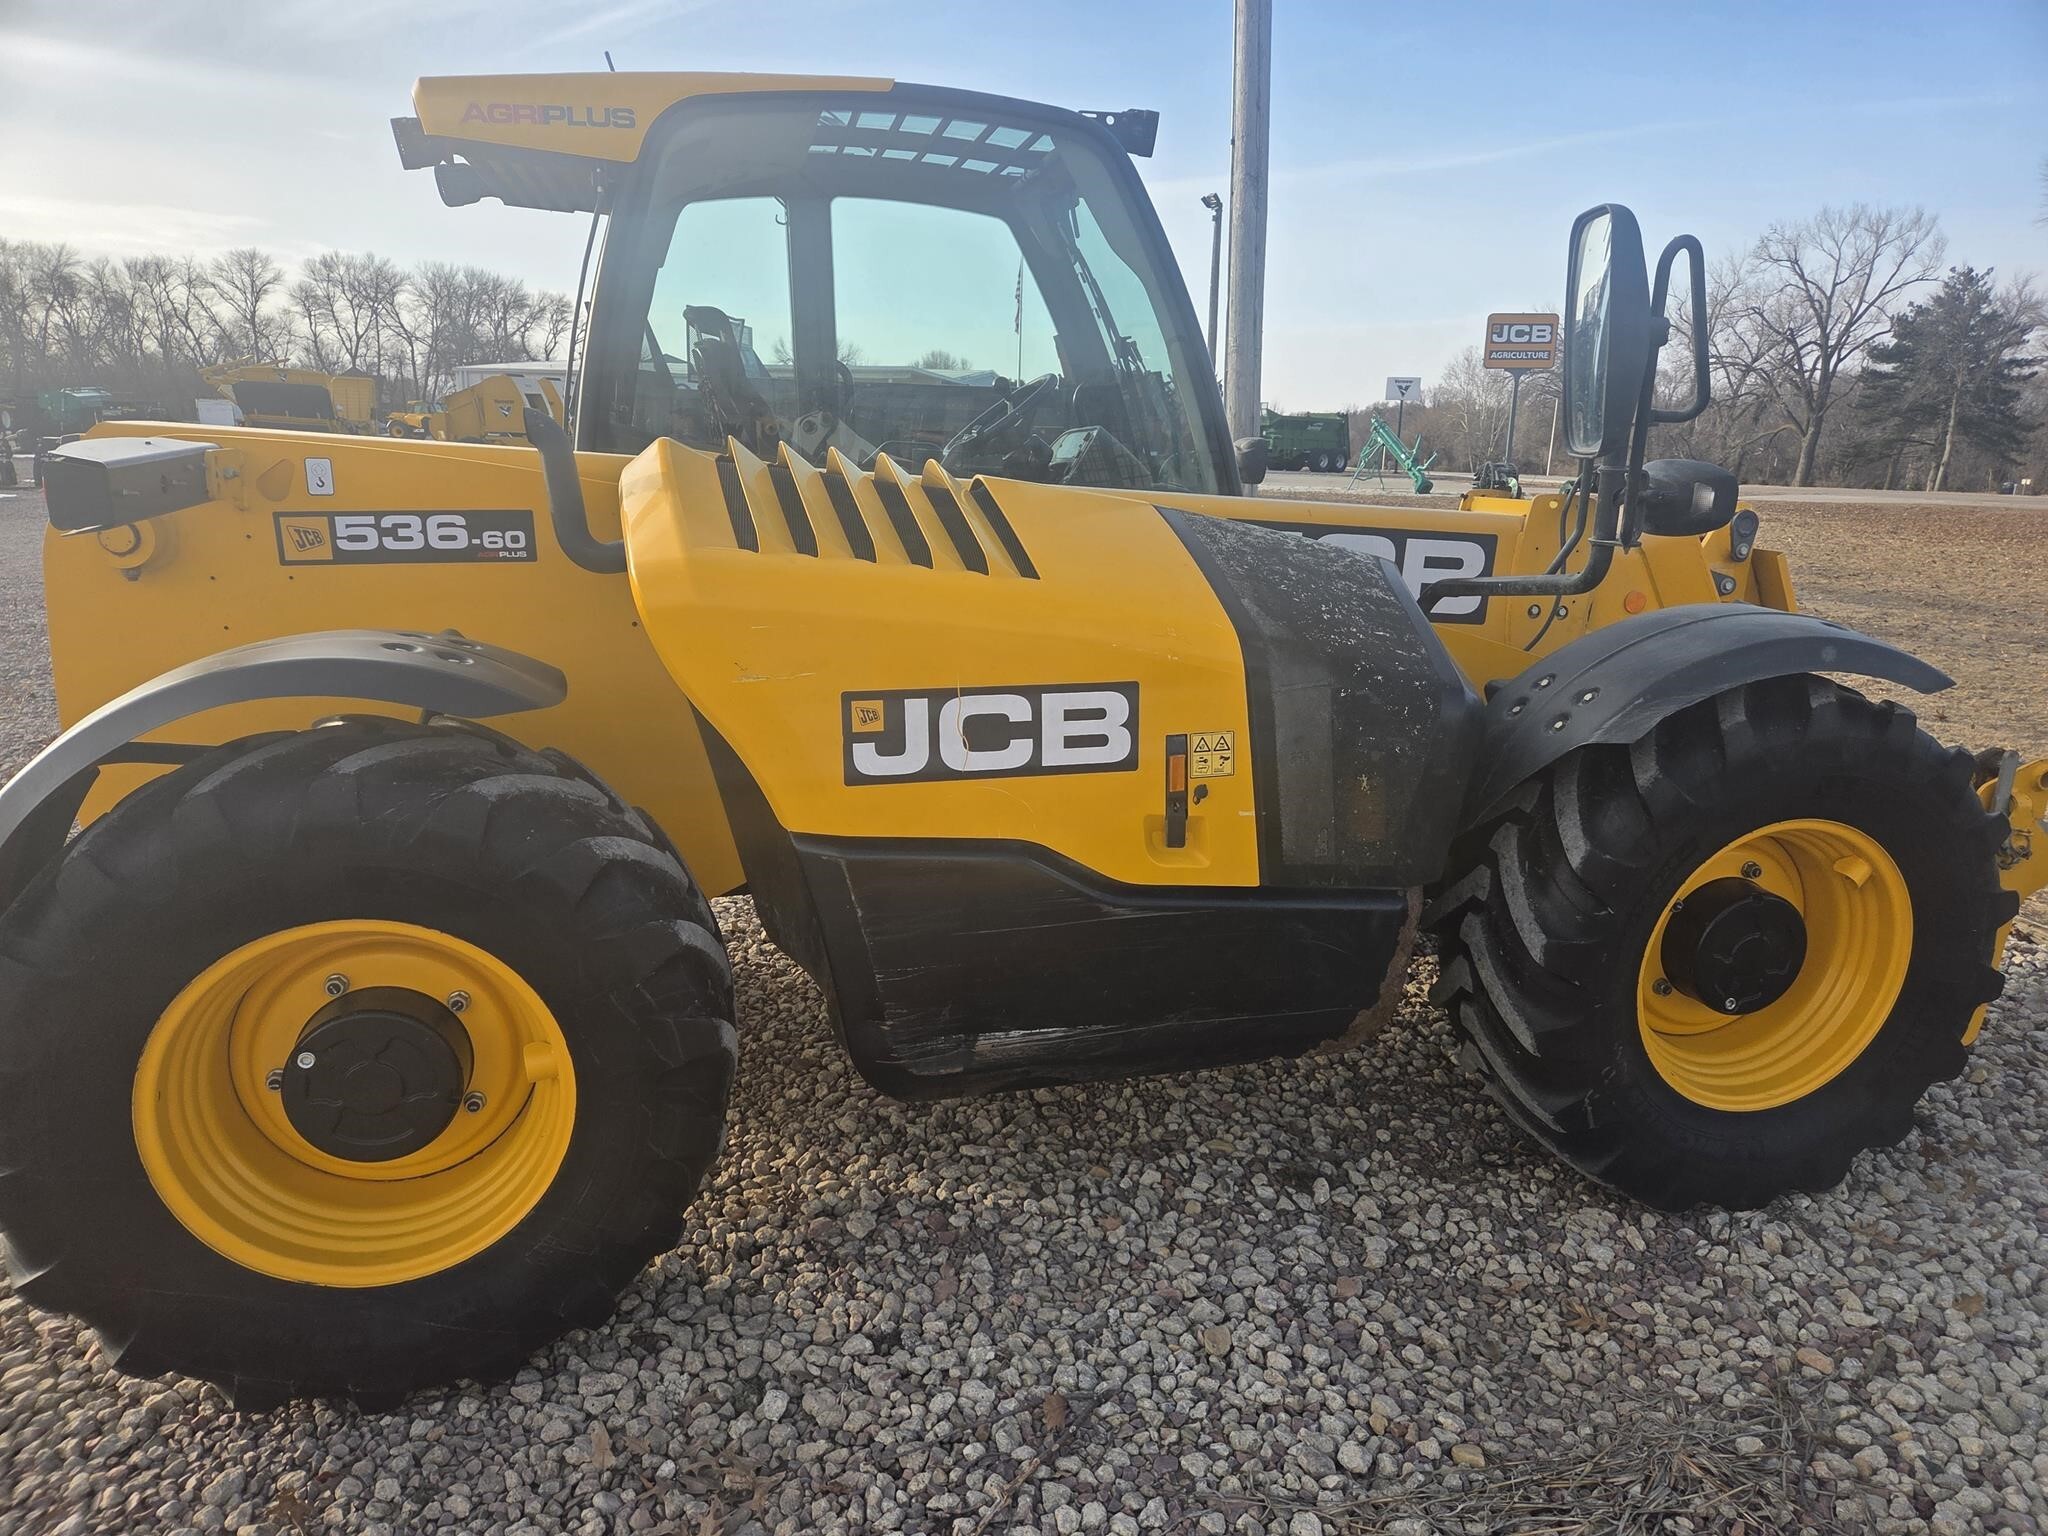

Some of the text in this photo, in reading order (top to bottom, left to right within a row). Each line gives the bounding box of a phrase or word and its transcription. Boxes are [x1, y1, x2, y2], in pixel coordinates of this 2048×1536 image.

[460, 102, 637, 129] AGRIPLUS
[1492, 324, 1552, 343] JCB
[1490, 351, 1549, 359] AGRICULTURE
[293, 527, 323, 550] JCB
[334, 514, 526, 551] 536-60
[860, 708, 879, 724] JCB
[852, 690, 1132, 776] JCB
